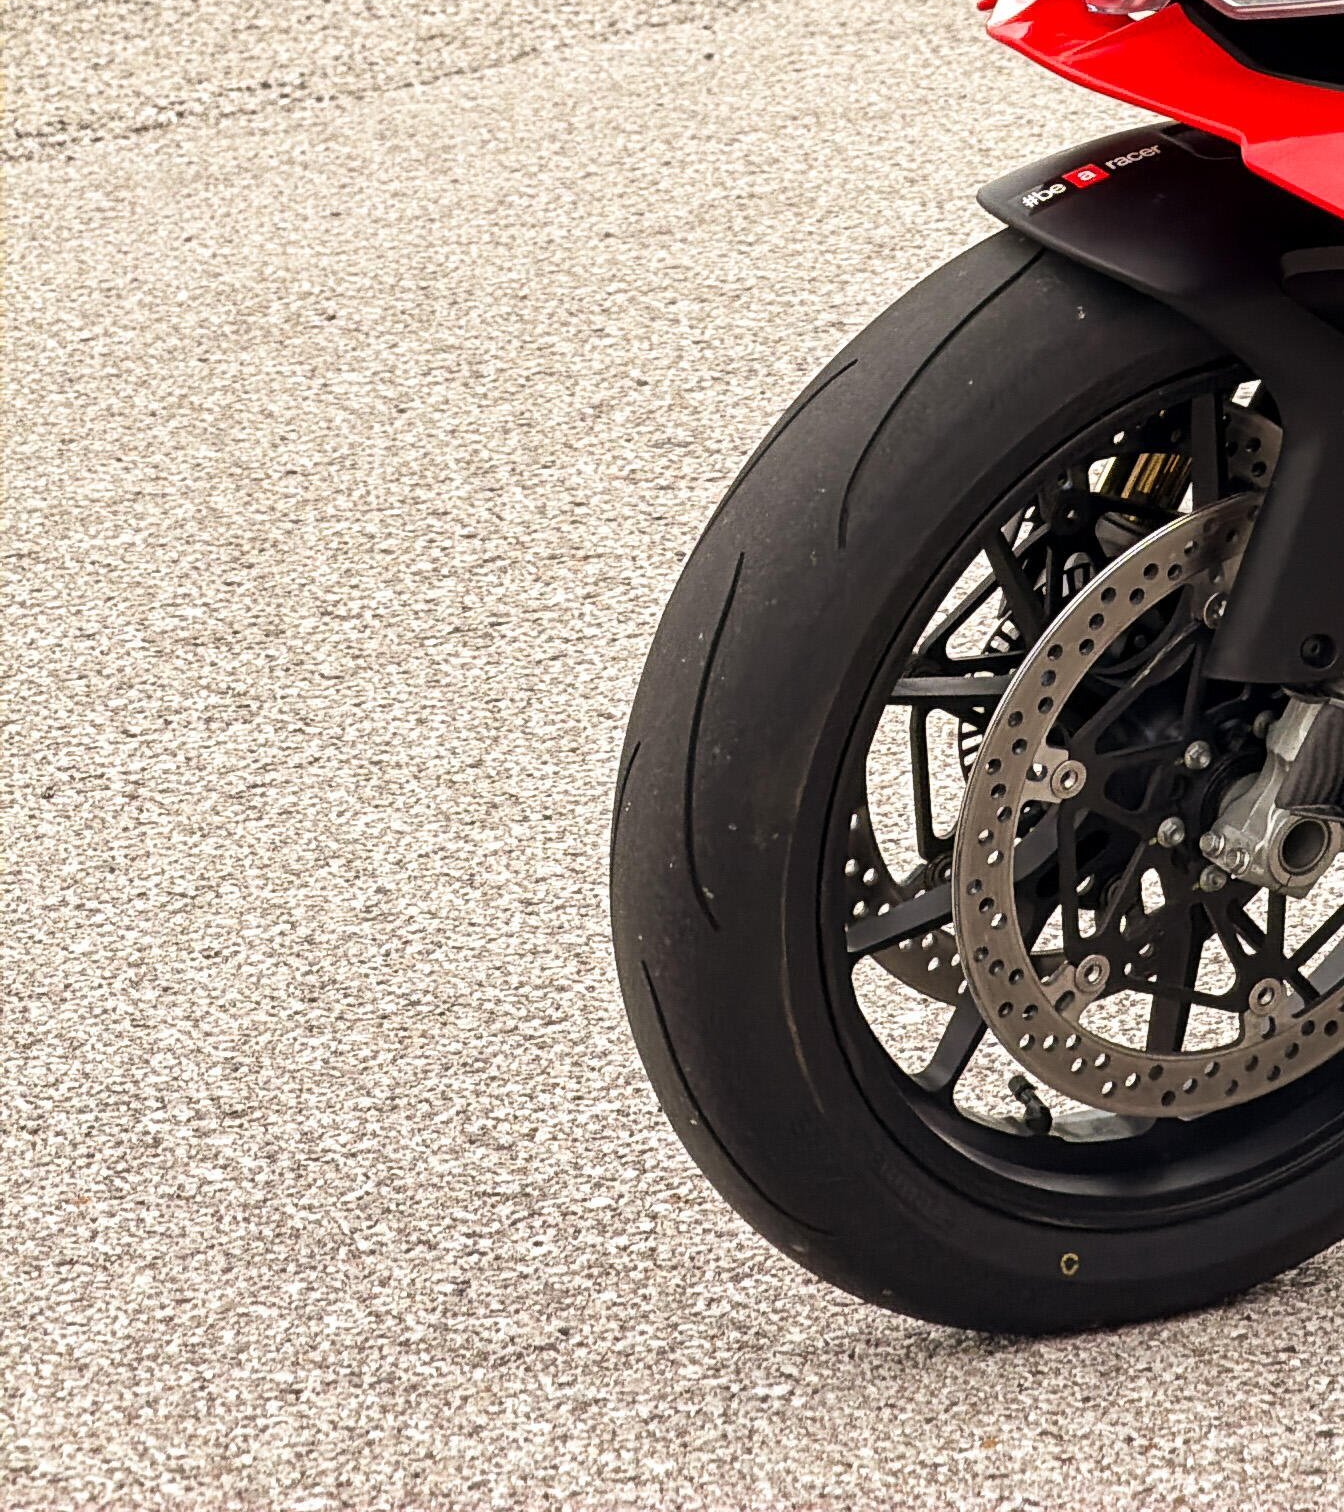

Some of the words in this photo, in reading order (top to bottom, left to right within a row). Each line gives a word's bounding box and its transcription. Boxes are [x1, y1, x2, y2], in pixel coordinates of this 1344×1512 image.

[1021, 183, 1067, 209] #be
[1077, 170, 1097, 182] a
[1104, 144, 1162, 170] racer
